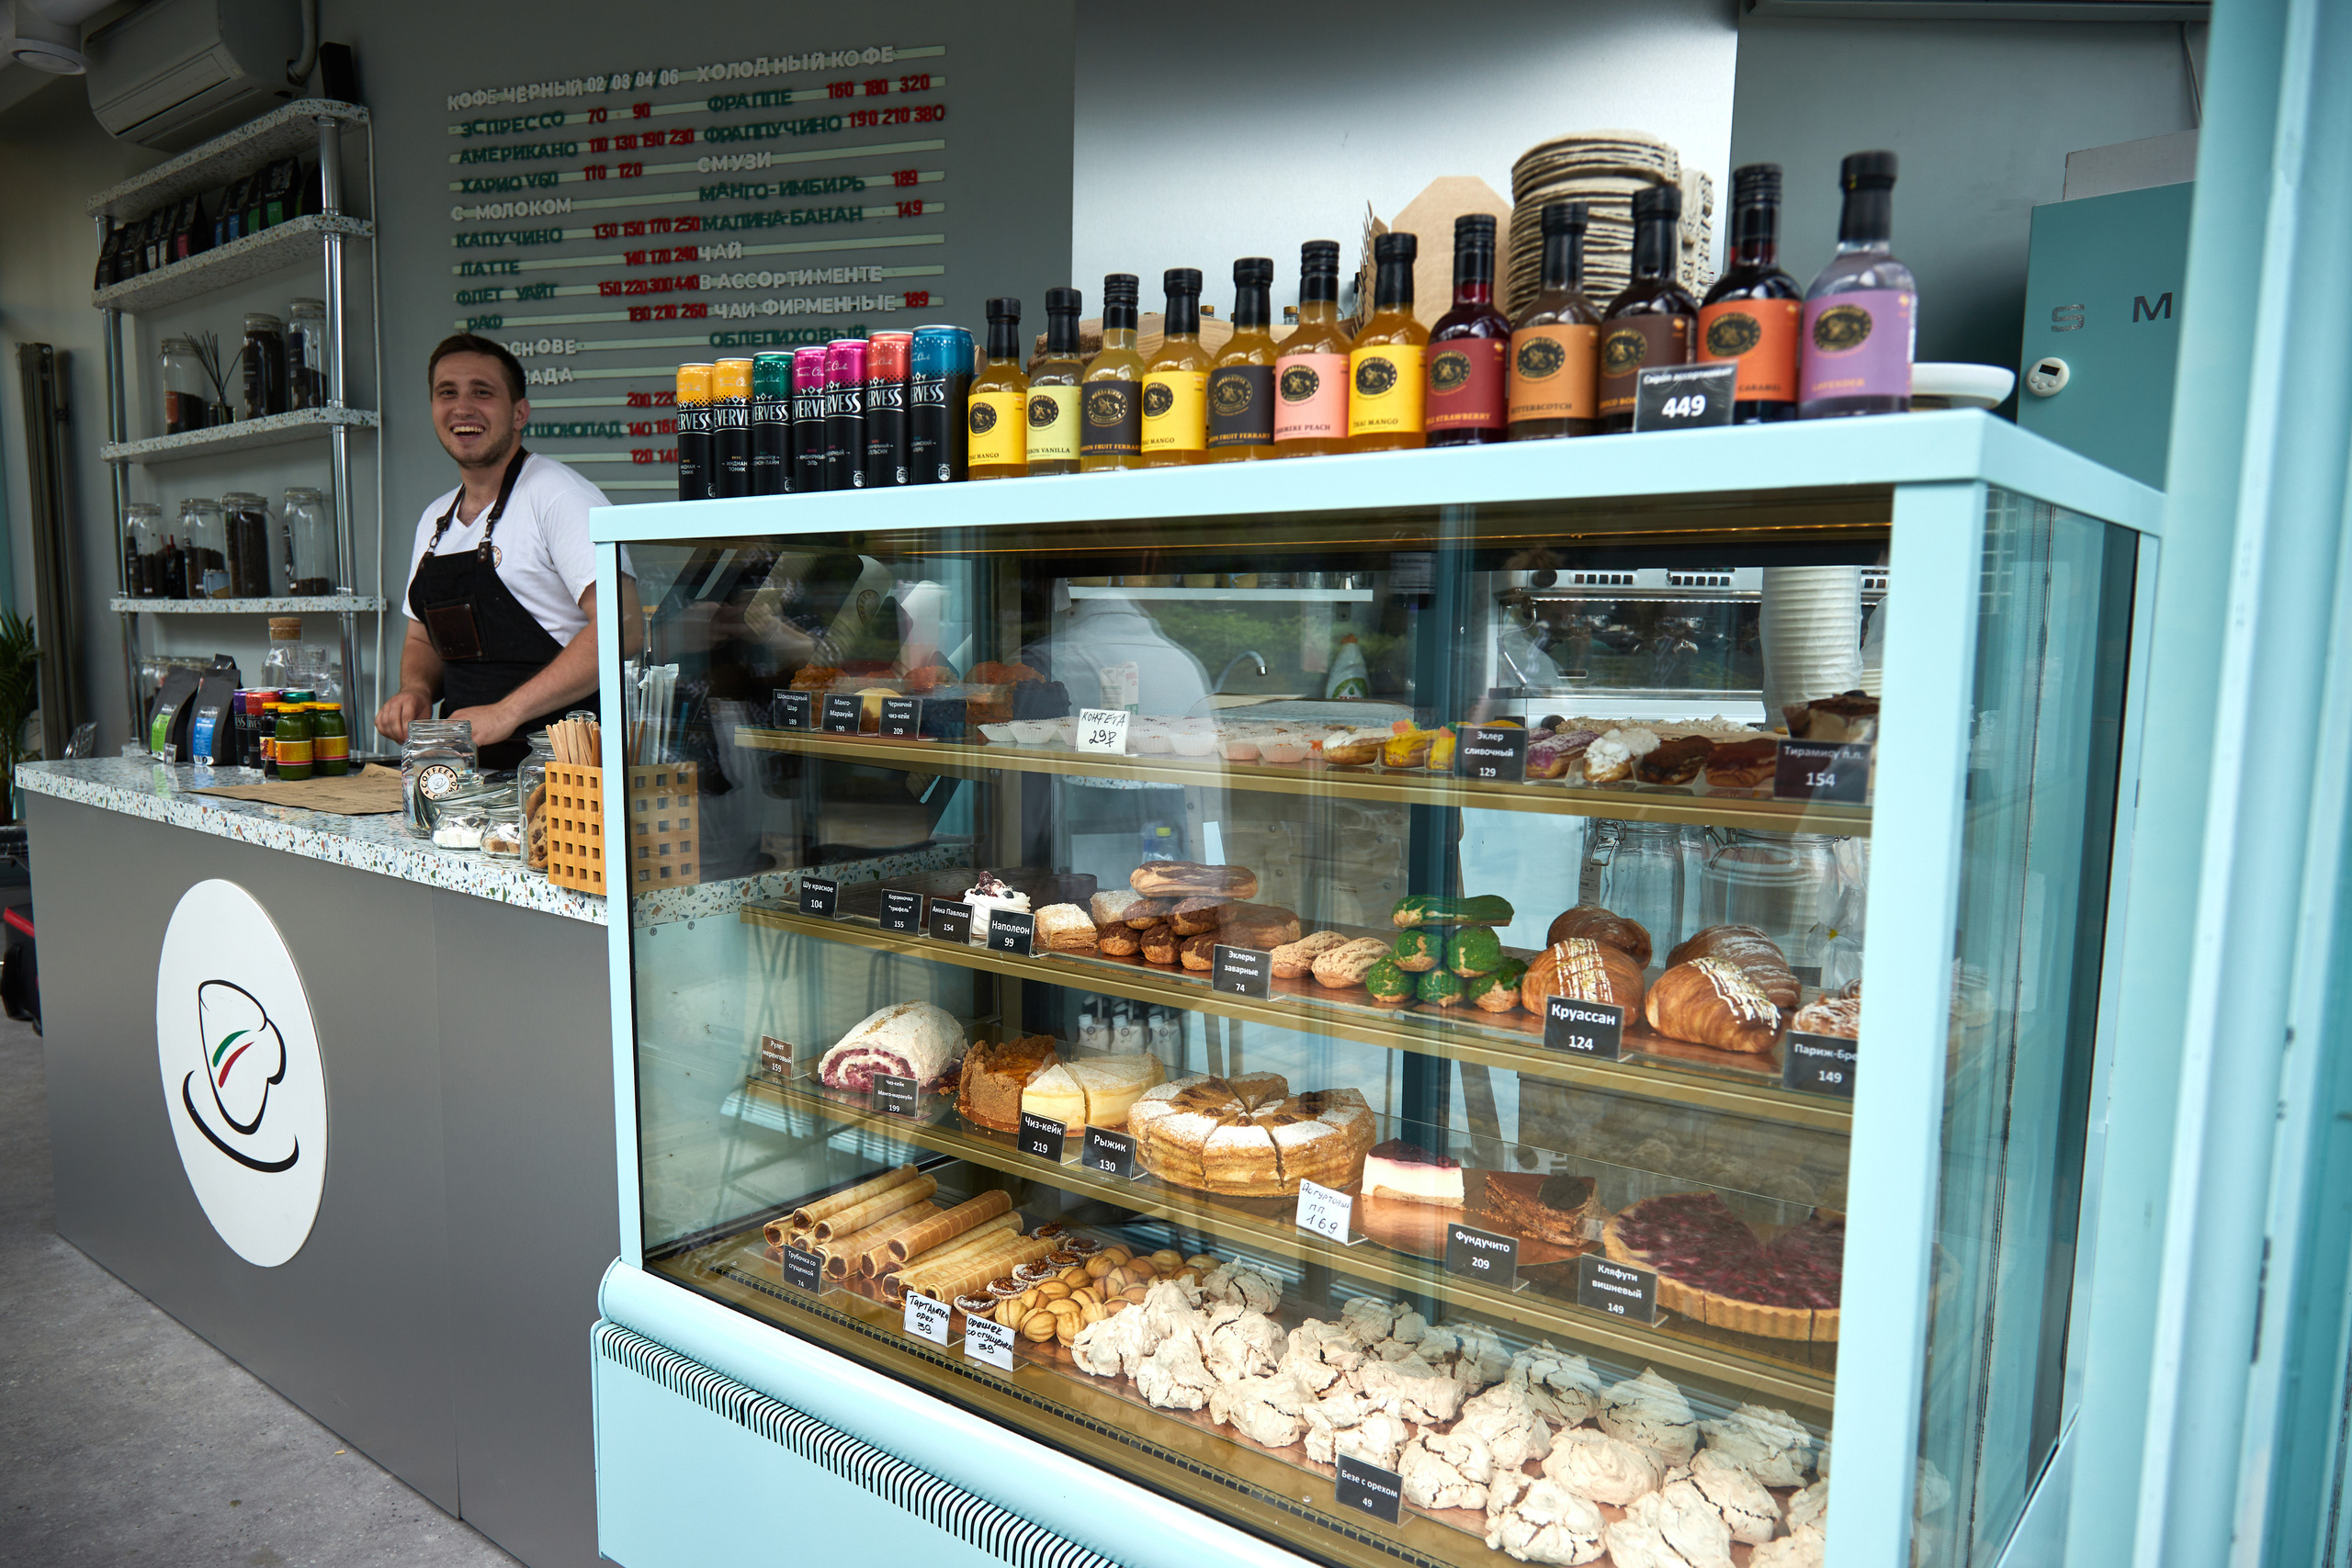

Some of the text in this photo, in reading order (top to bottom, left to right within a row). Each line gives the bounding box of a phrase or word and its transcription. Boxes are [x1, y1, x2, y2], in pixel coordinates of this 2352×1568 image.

[696, 46, 894, 83] ХОЛОДНЫЙ КОФЕ
[447, 88, 497, 110] КОФЕ
[586, 68, 679, 93] 02/03/04/06
[707, 73, 931, 113] ФРАППЕ 160 180 320
[459, 103, 650, 138] ЭСПРЕССО 70 90
[704, 104, 944, 143] ФРАППУЧИНО 190 210 380
[459, 129, 695, 164] АМЕРИКАНО 110 130 190 230
[696, 152, 772, 173] СМУЗИ
[460, 163, 642, 194] ХАРИО V60 110 120
[891, 169, 919, 187] 189
[451, 197, 572, 221] С МОЛОКОМ
[702, 199, 923, 231] МАЛИНА-БАНАН 149
[456, 216, 700, 248] КАПУЧИНО 130 150 170 250
[697, 242, 742, 261] ЧАЙ
[459, 246, 698, 276] ЛАТТЕ 140 170 240
[699, 265, 883, 290] В АССОРТИМЕНТЕ
[456, 275, 700, 305] ФЛЕТ УАЙТ 150 220 300 440
[762, 294, 896, 316] ФИРМЕННЫЕ
[902, 290, 930, 308] 189
[467, 303, 707, 332] РАФ 180 210 260
[708, 325, 866, 348] ОБЛЕПИХОВЫЙ
[526, 367, 574, 386] АДА
[626, 392, 651, 408] 200
[1661, 393, 1707, 419] 449
[1368, 418, 1398, 426] MANGO
[1436, 412, 1491, 423] STRAWBERRY
[535, 421, 623, 439] ШОКОЛАД
[627, 422, 652, 437] 140
[629, 449, 653, 465] 120
[776, 693, 808, 702] Шоколадный
[786, 705, 797, 713] Шар
[829, 709, 854, 719] Маракуйя
[1080, 711, 1126, 727] КОНФЕТА
[835, 725, 845, 733] 190
[893, 728, 903, 736] 209
[1476, 731, 1504, 742] Эклер
[1464, 747, 1514, 757] сливочный
[1784, 746, 1840, 760] Тирамису
[421, 767, 449, 788] COFFEE
[1479, 767, 1497, 777] 129
[1805, 772, 1836, 787] 154
[802, 880, 834, 893] Шу красное
[810, 899, 823, 909] 104
[888, 893, 913, 903] Корзиночка
[932, 905, 969, 919] Анна Павлова
[894, 919, 904, 929] 155
[944, 923, 954, 932] 154
[991, 919, 1031, 935] Наполеон
[1004, 937, 1014, 948] 99
[1228, 950, 1256, 963] Эклеры
[1224, 964, 1259, 976] заварные
[1236, 983, 1246, 993] 74
[1551, 1003, 1616, 1026] Круассан
[770, 1040, 785, 1052] Рулет
[1568, 1034, 1594, 1051] 124
[762, 1049, 792, 1064] меренговый
[772, 1062, 782, 1073] 159
[1818, 1070, 1842, 1084] 149
[888, 1104, 900, 1112] 199
[1024, 1115, 1063, 1136] Чиз-кейк
[1033, 1141, 1048, 1154] 219
[1093, 1134, 1126, 1153] Рыжик
[1099, 1158, 1115, 1172] 130
[1306, 1214, 1339, 1235] 169
[1455, 1231, 1510, 1253] Фундучито
[787, 1250, 809, 1264] Трубочка
[1471, 1257, 1490, 1269] 209
[1598, 1264, 1638, 1282] Кляфути
[1591, 1280, 1643, 1300] вишневый
[1608, 1303, 1625, 1314] 149
[916, 1312, 934, 1324] орех
[917, 1322, 933, 1335] 39
[966, 1328, 976, 1337] со
[978, 1342, 994, 1354] 39
[1341, 1470, 1398, 1498] Безе с орехом
[1363, 1497, 1373, 1507] 49
